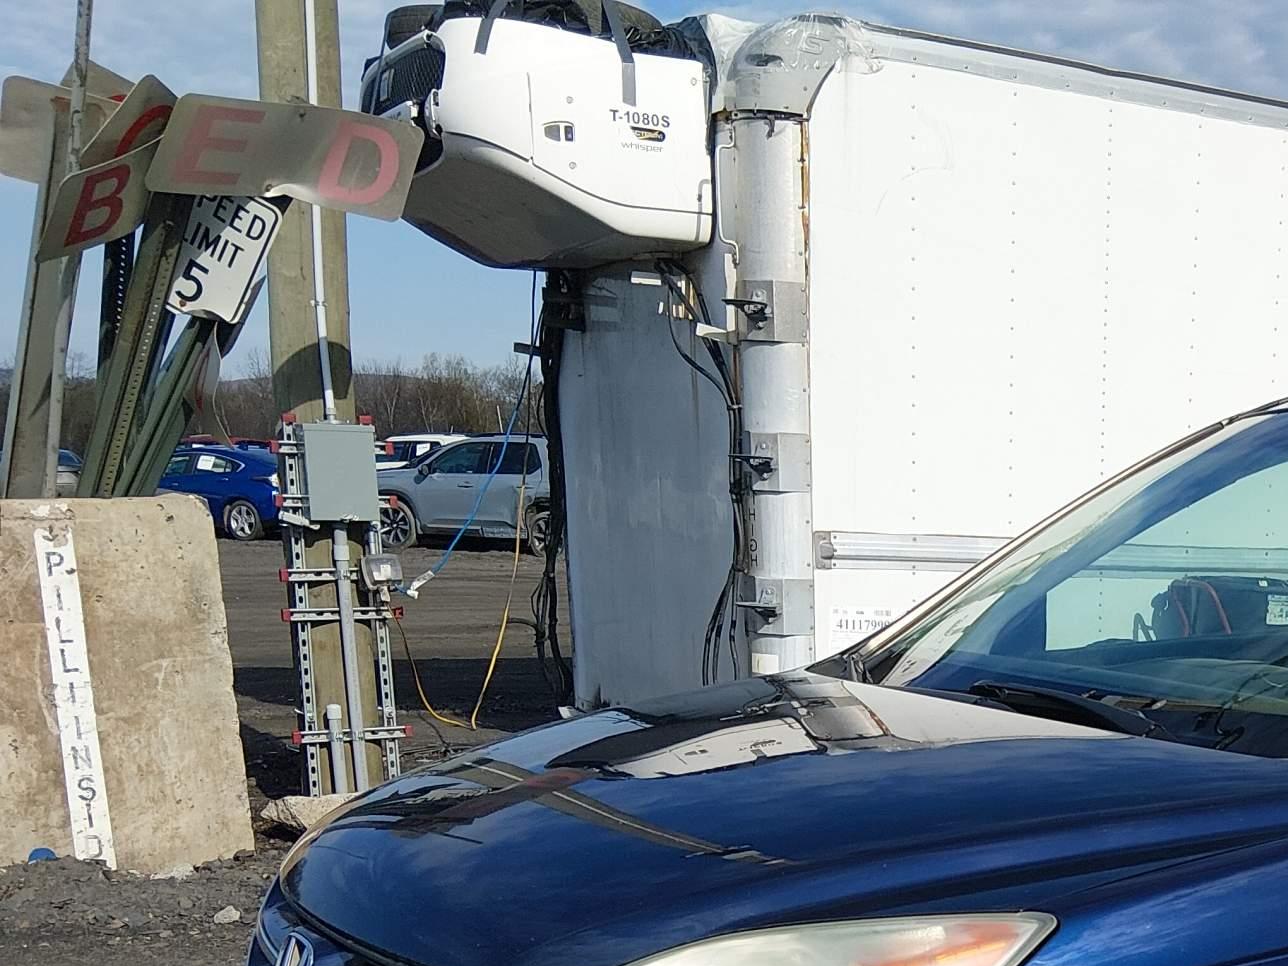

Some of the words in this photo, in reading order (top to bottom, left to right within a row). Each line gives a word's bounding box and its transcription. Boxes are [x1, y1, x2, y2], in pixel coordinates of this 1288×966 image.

[609, 109, 671, 128] T-1080S
[317, 119, 400, 205] D
[621, 141, 664, 153] whisper
[64, 164, 131, 247] B
[196, 195, 266, 241] PEED
[175, 258, 210, 302] 5
